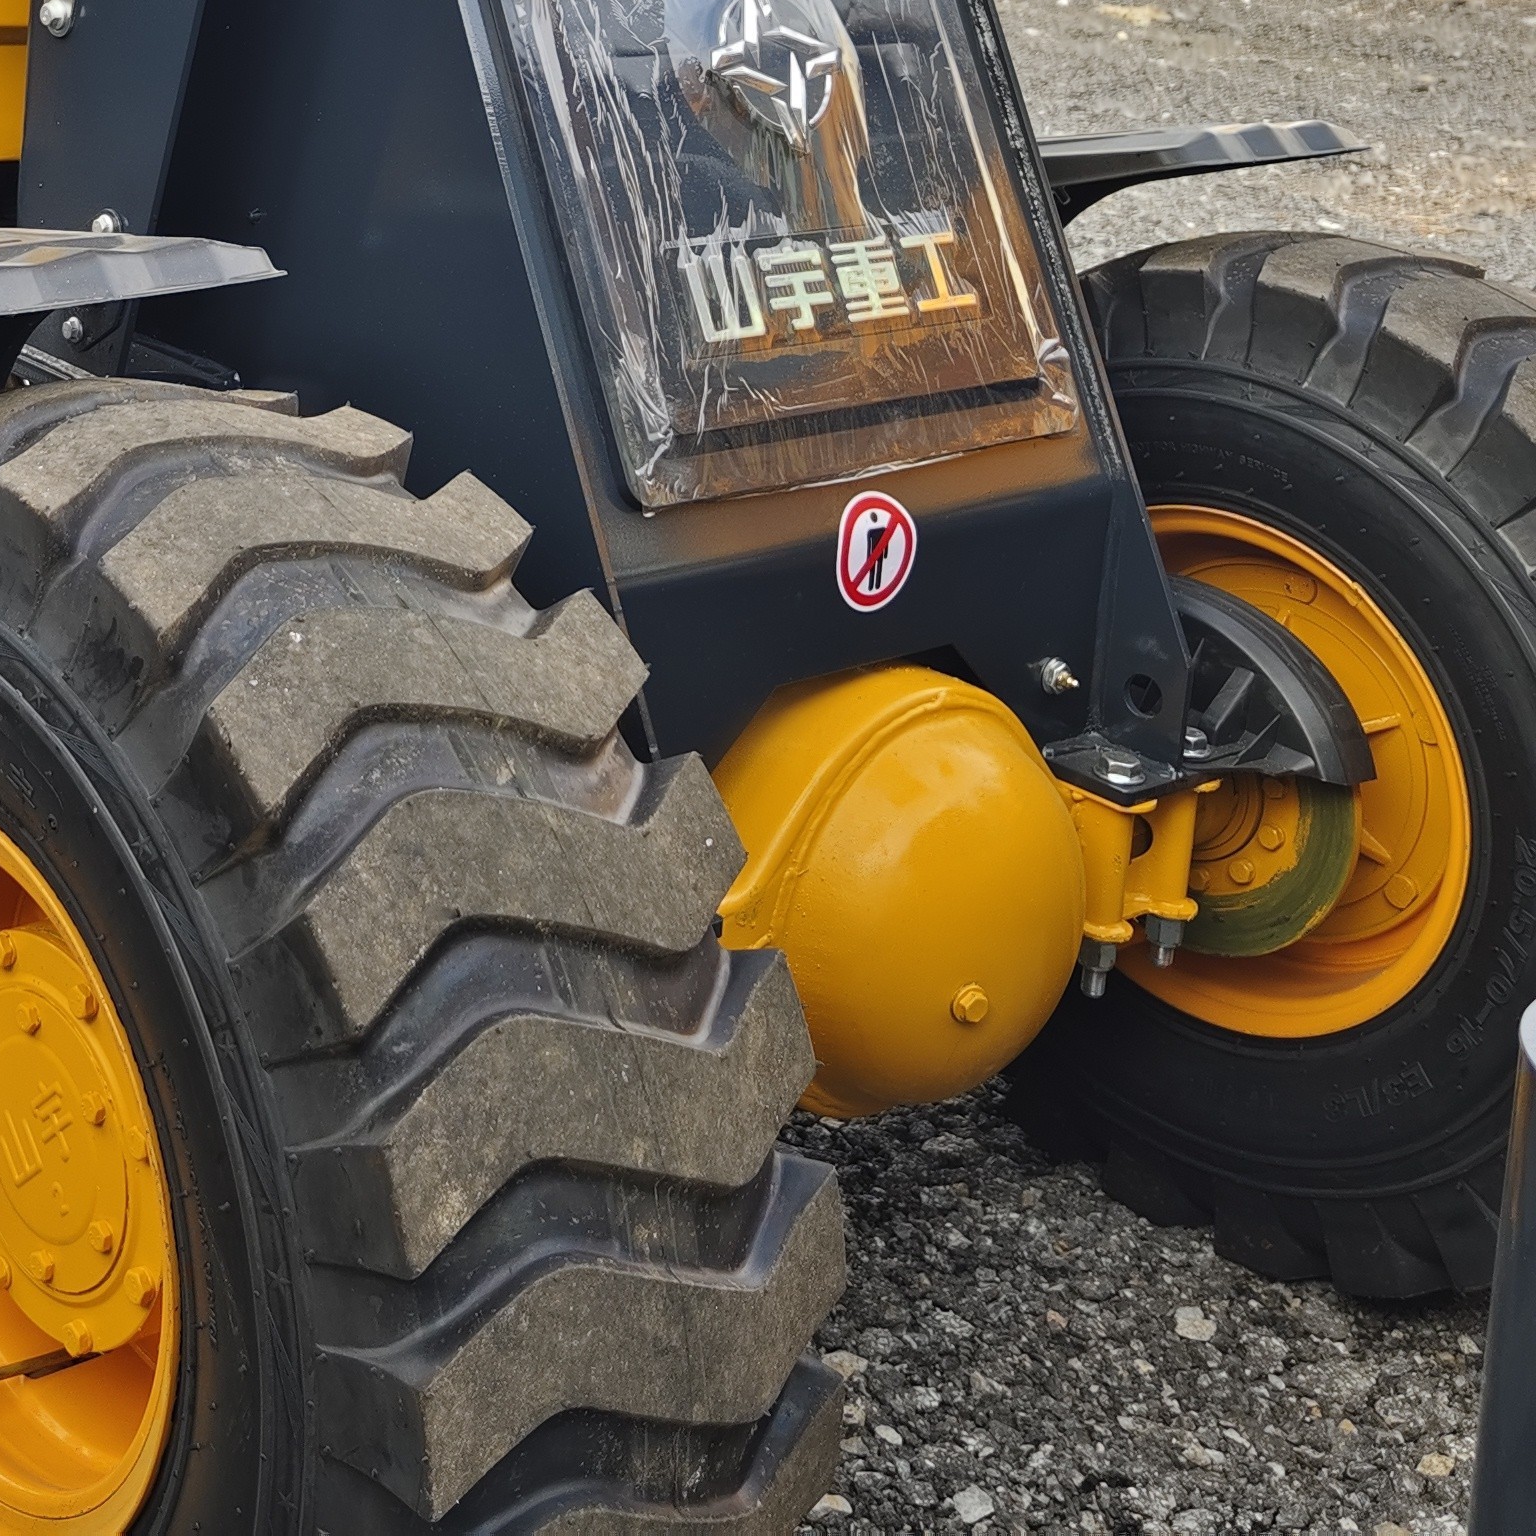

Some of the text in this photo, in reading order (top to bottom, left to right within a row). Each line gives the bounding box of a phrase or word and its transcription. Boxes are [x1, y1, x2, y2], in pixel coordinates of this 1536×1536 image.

[678, 231, 977, 343] 山宇重工
[0, 1080, 75, 1188] 山宇
